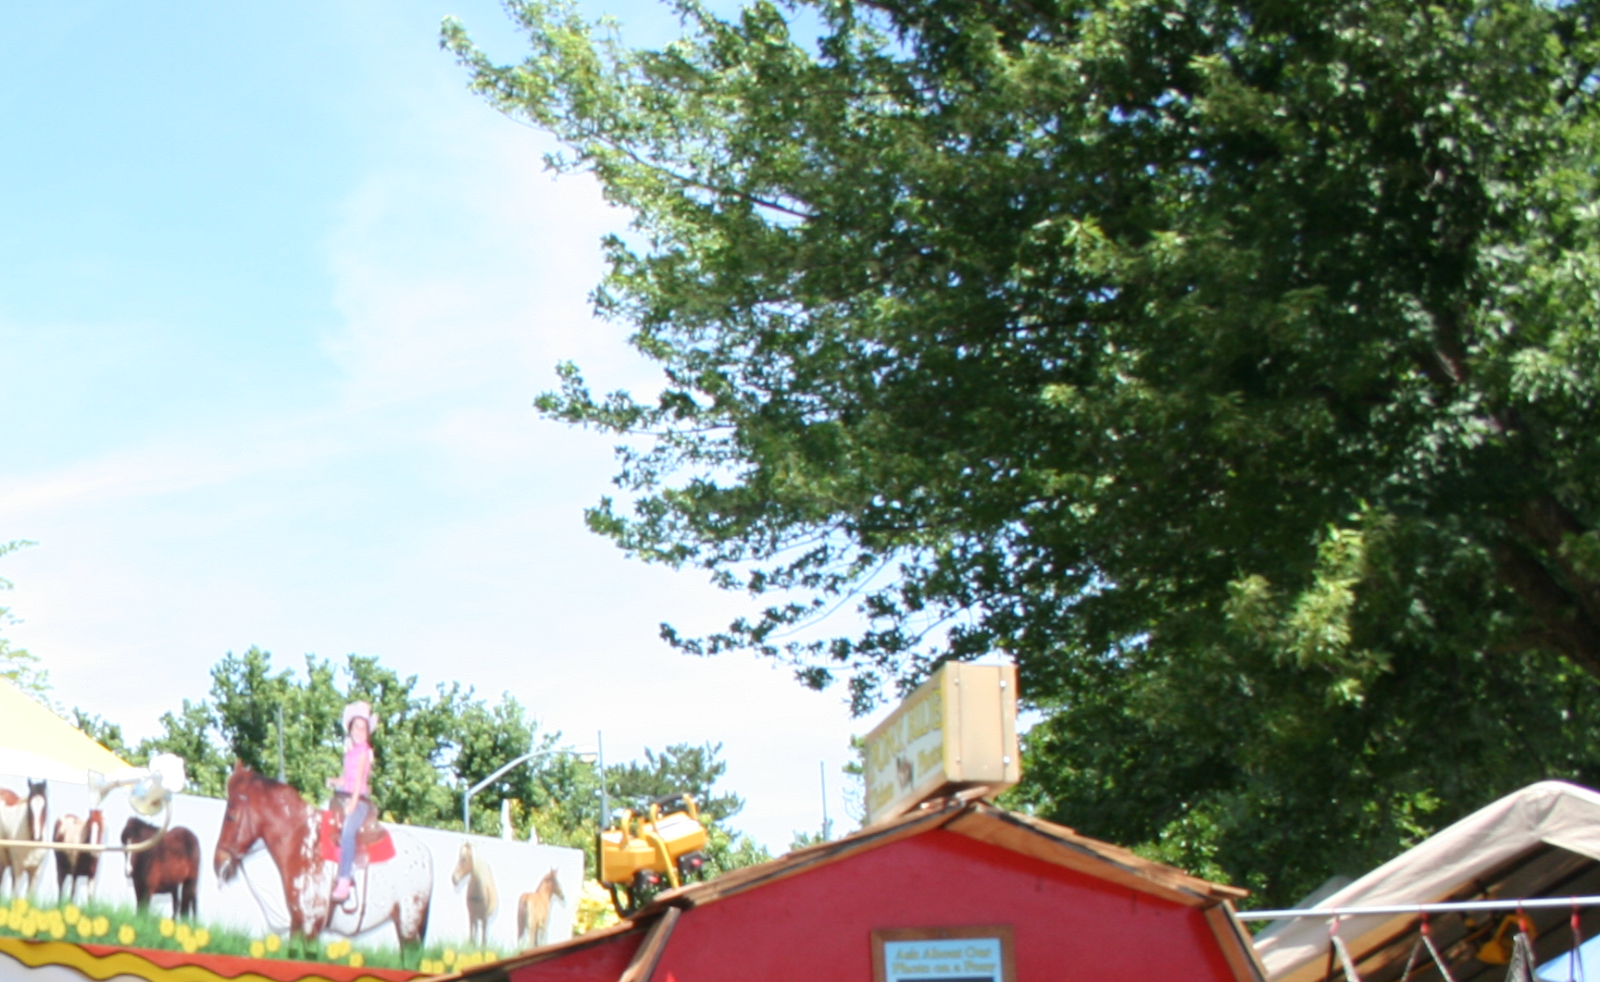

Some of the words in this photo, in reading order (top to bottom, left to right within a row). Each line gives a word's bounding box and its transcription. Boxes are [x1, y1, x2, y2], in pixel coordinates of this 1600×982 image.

[896, 947, 920, 960] Ask
[923, 946, 962, 960] About
[964, 945, 992, 958] Our
[892, 961, 931, 974] Photo
[933, 964, 950, 973] on
[953, 964, 961, 973] a
[963, 960, 996, 975] Pony
